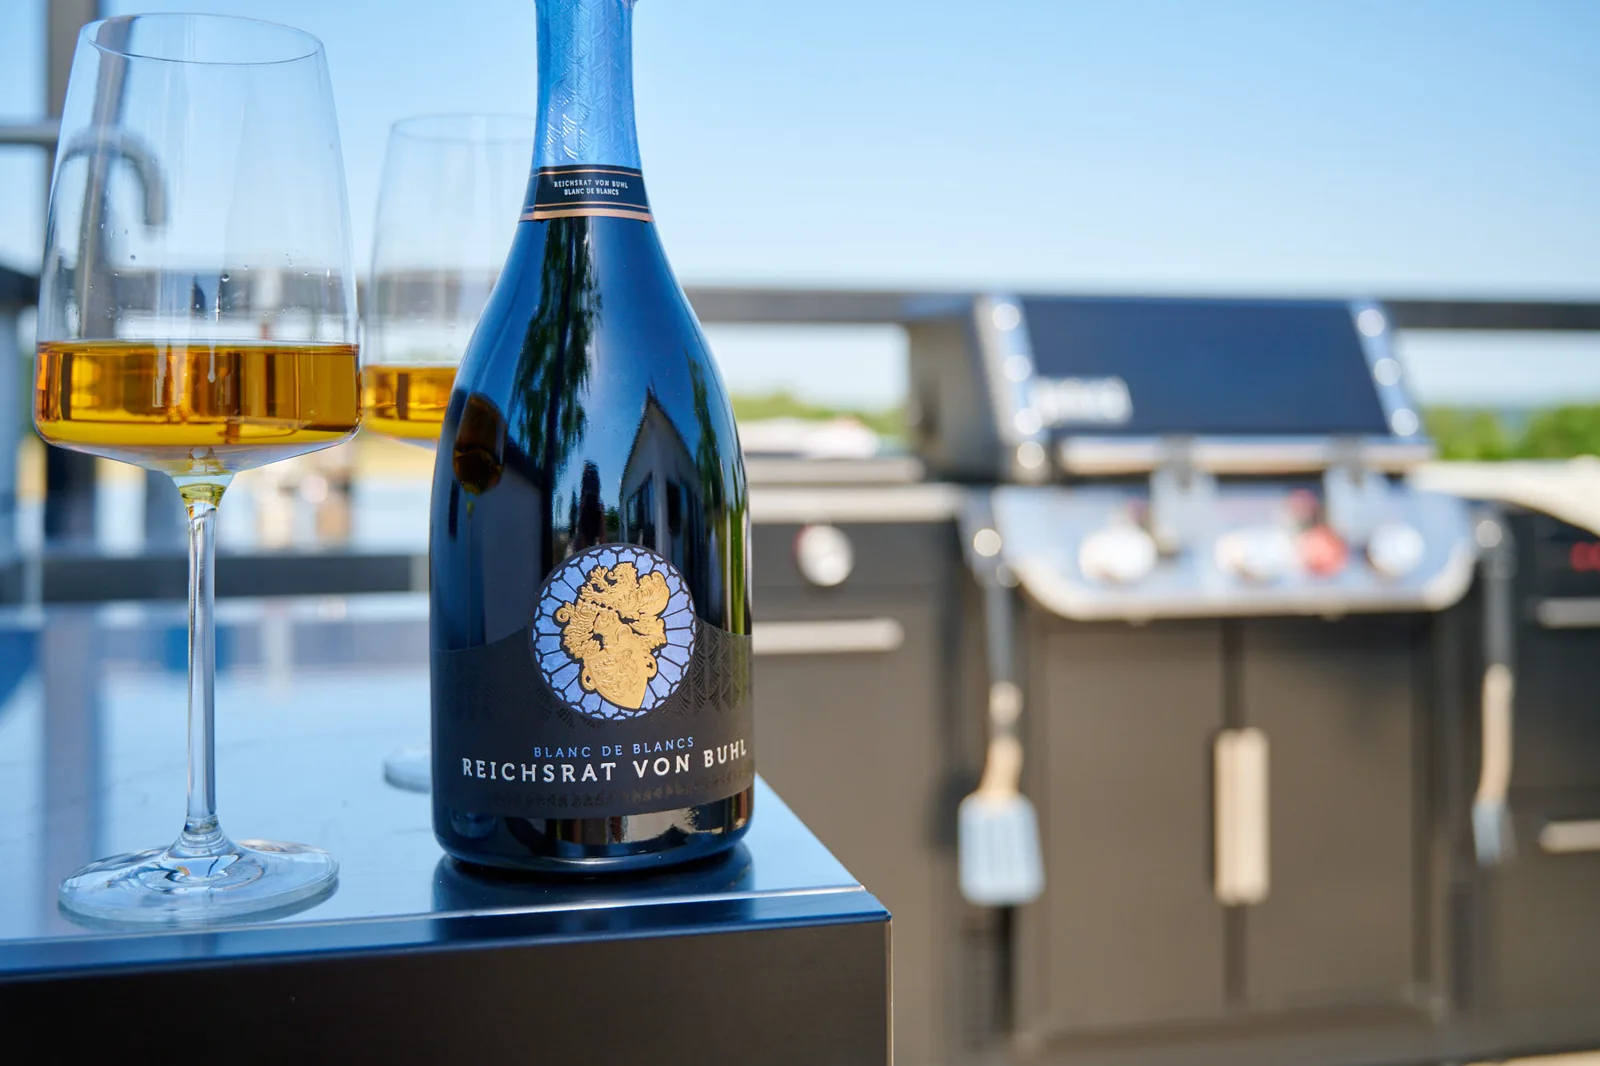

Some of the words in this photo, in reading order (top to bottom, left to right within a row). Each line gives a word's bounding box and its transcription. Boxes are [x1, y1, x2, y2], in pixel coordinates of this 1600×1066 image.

[553, 180, 592, 188] REICHSRAT
[595, 179, 610, 187] VON
[611, 181, 629, 189] BUHL
[564, 188, 585, 196] BLANC
[596, 188, 619, 196] BLANCS
[534, 747, 591, 758] BLANC
[602, 745, 623, 757] DE
[633, 736, 694, 754] BLANCS
[462, 757, 617, 783] REICHSRAT
[632, 753, 690, 779] VON
[703, 738, 747, 768] BUHL
